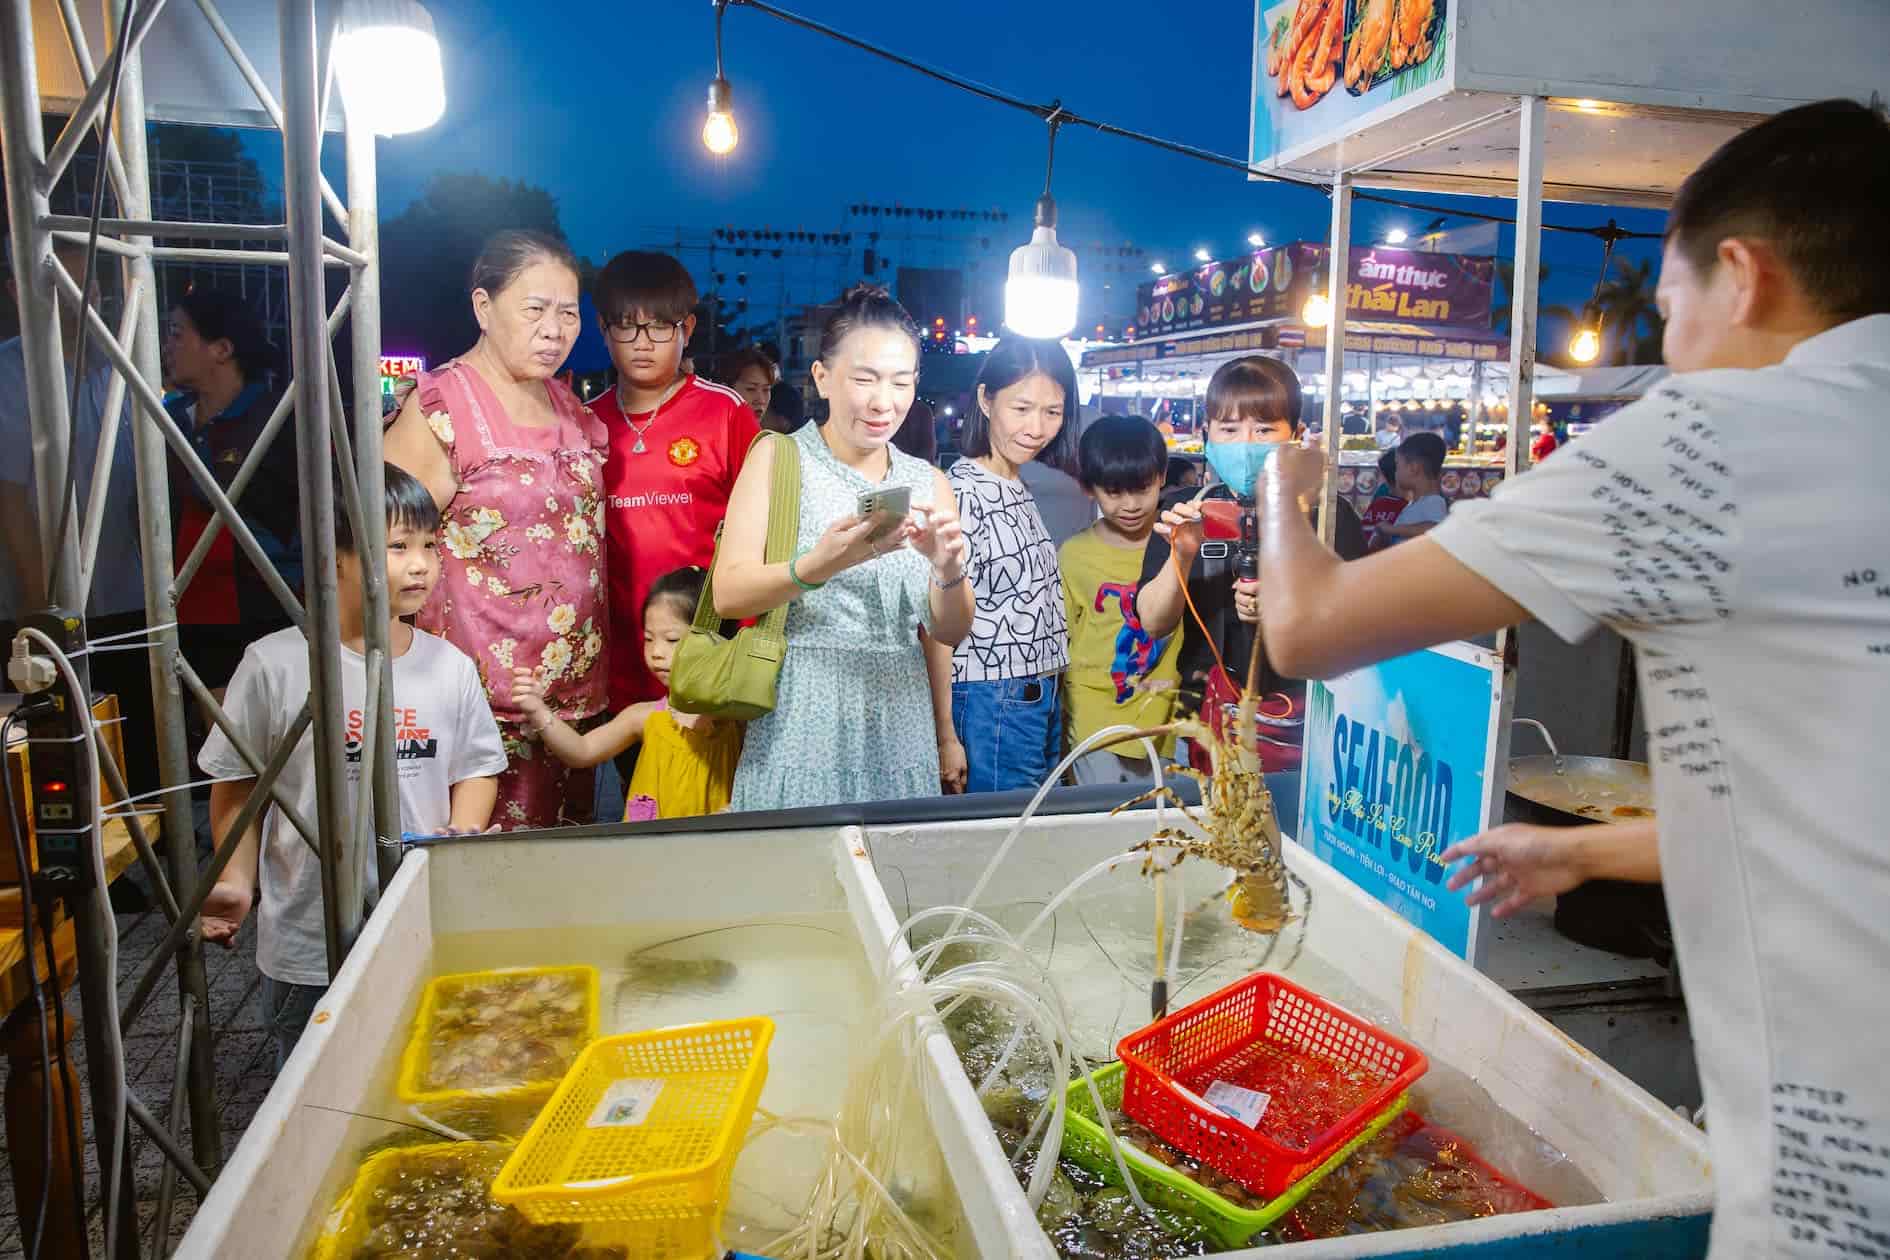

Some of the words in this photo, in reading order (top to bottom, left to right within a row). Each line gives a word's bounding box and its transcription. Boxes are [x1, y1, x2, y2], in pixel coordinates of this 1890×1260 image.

[1396, 264, 1448, 290] thực
[1397, 292, 1450, 319] Lan
[1663, 436, 1701, 462] YOU
[1328, 713, 1453, 885] SEAFOOD
